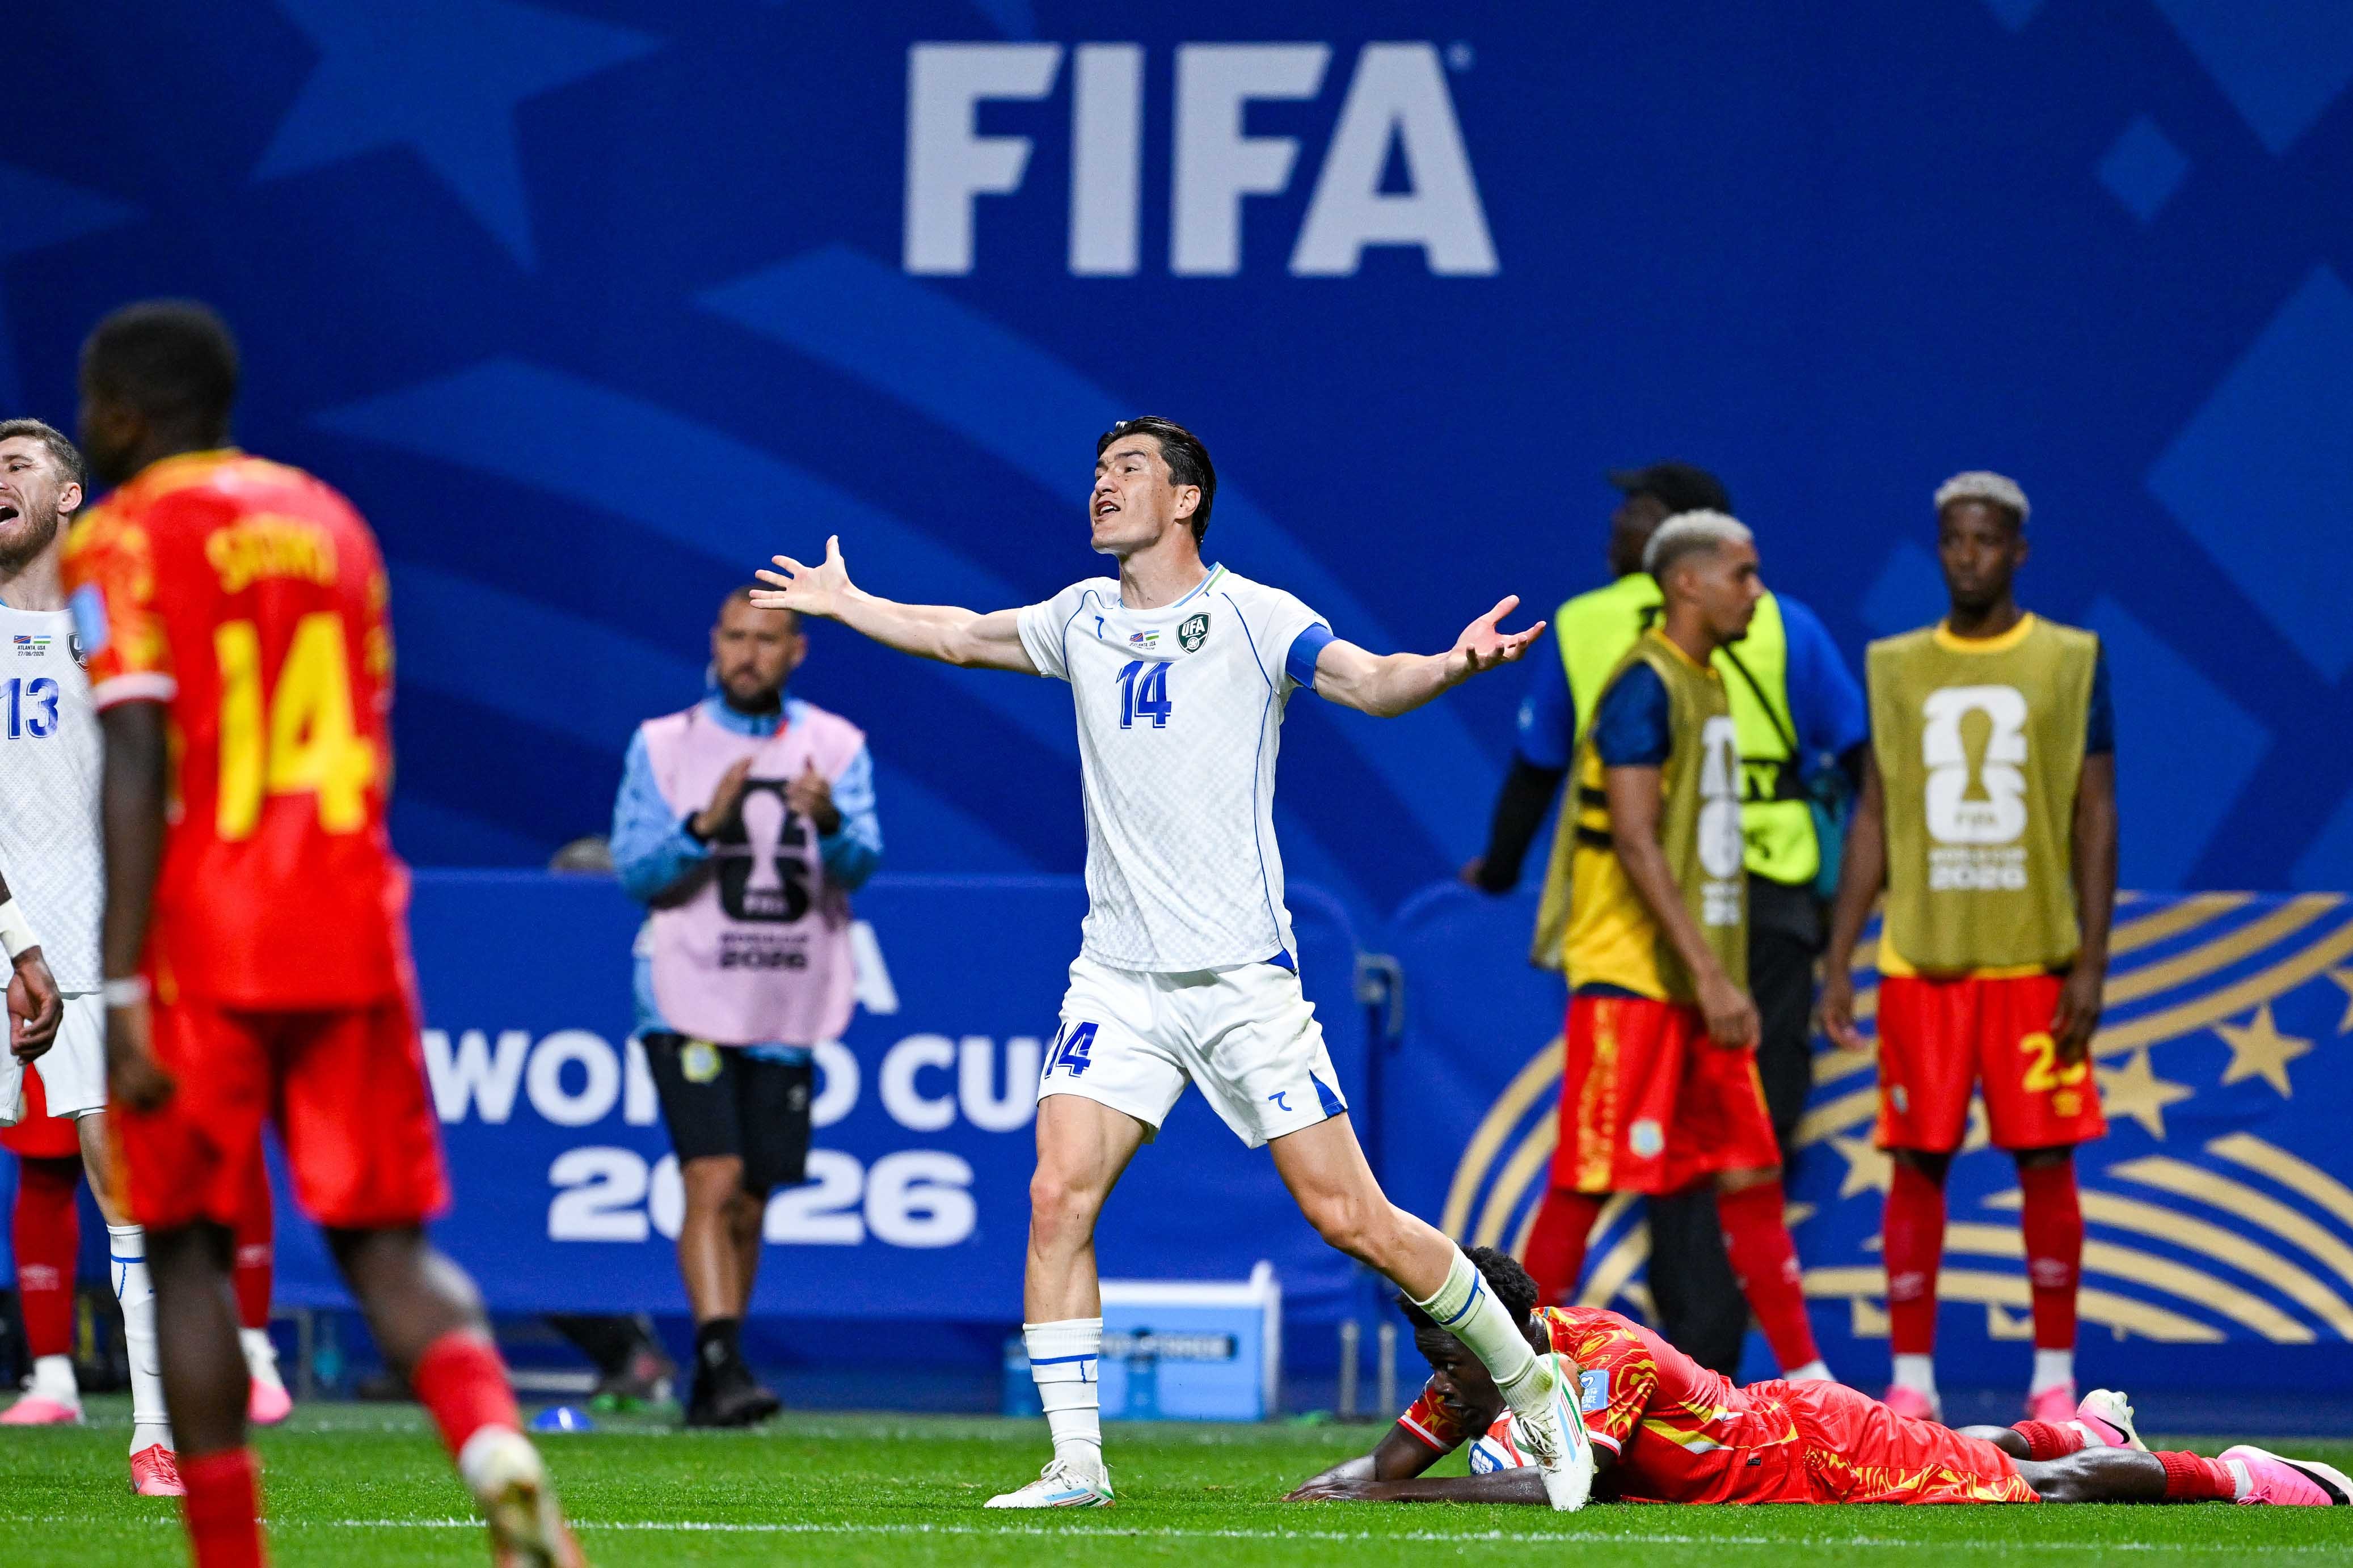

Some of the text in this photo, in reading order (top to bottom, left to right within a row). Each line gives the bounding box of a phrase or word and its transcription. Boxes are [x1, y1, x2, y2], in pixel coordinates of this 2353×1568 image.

[905, 43, 1499, 275] FIFA
[1182, 619, 1205, 636] UFA
[0, 678, 58, 739] 13
[213, 611, 373, 843] 14
[1116, 660, 1173, 729] 14
[421, 1029, 1054, 1132] WOD CU
[1044, 1021, 1099, 1080] 14
[1582, 1396, 1597, 1404] EACE
